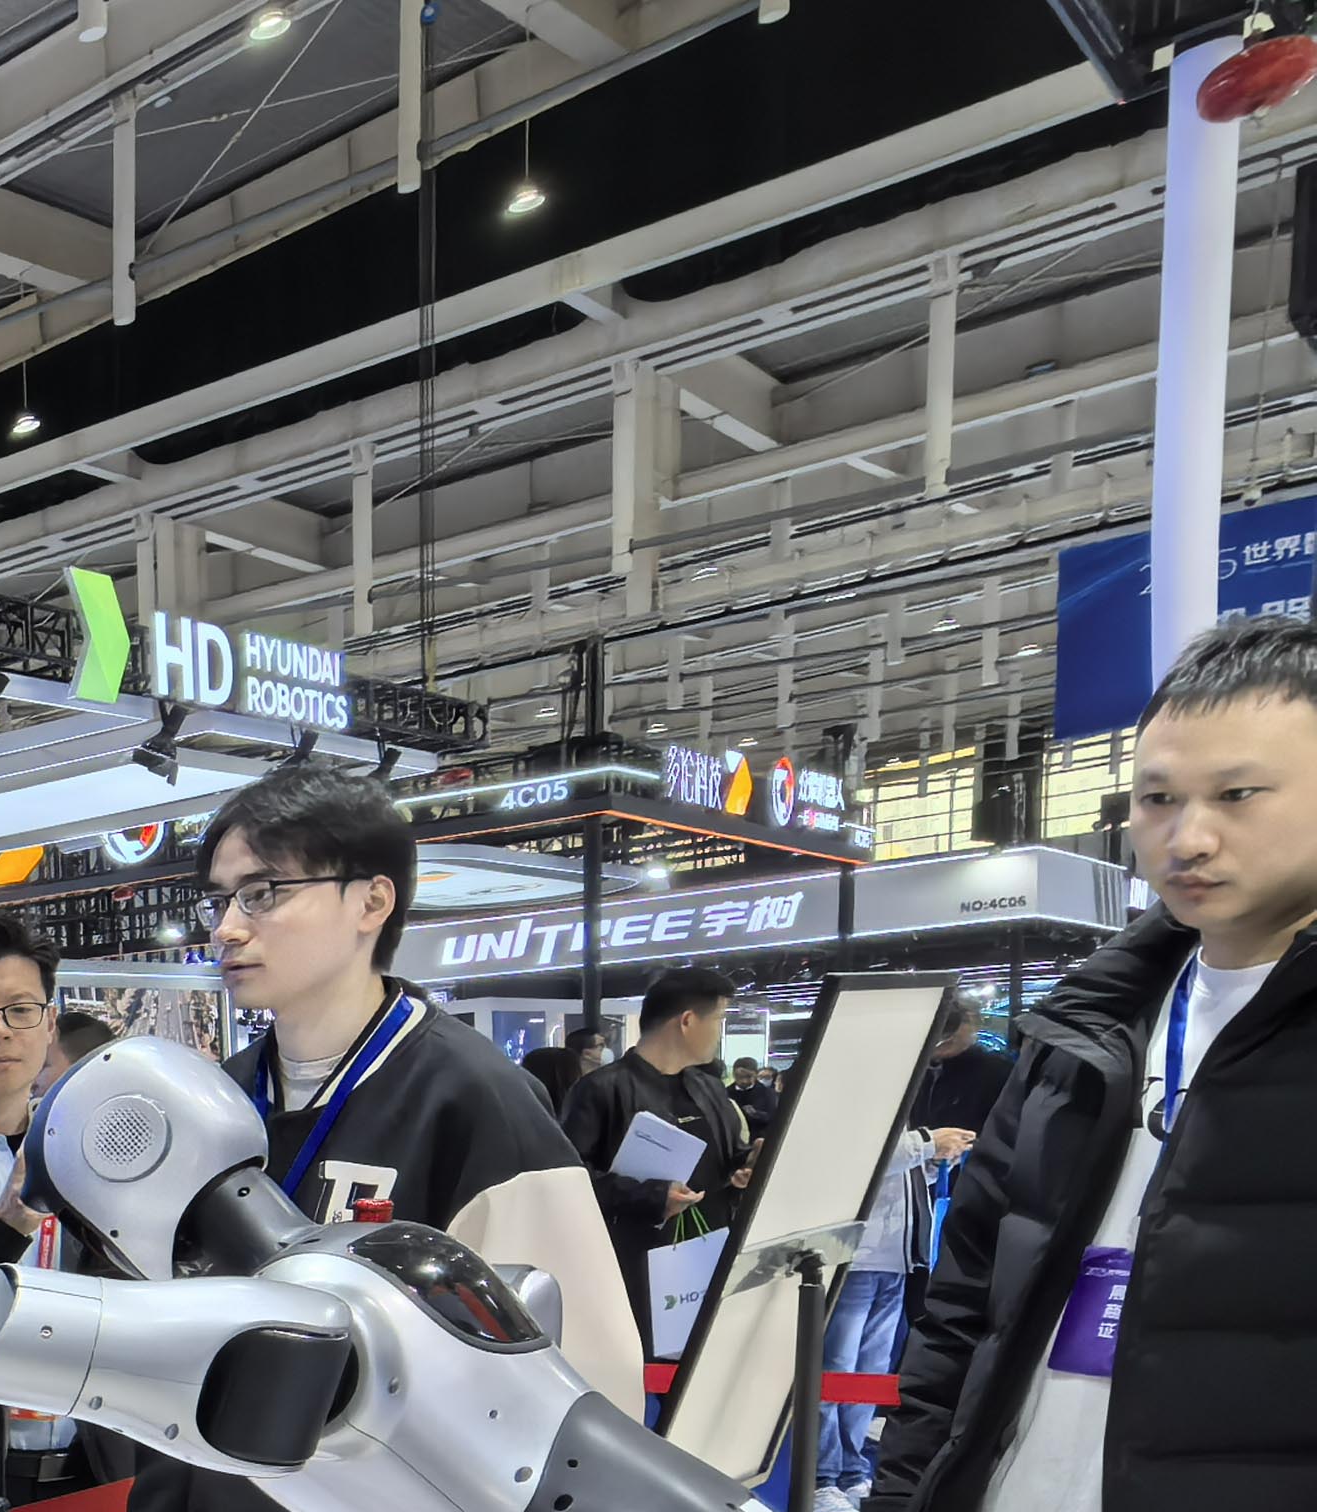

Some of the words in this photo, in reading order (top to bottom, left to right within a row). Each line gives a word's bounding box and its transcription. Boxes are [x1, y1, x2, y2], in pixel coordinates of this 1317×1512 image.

[154, 611, 233, 706] HD
[245, 634, 342, 687] HYUNDAI
[246, 677, 349, 730] ROBOTICS
[500, 780, 569, 810] 4C05
